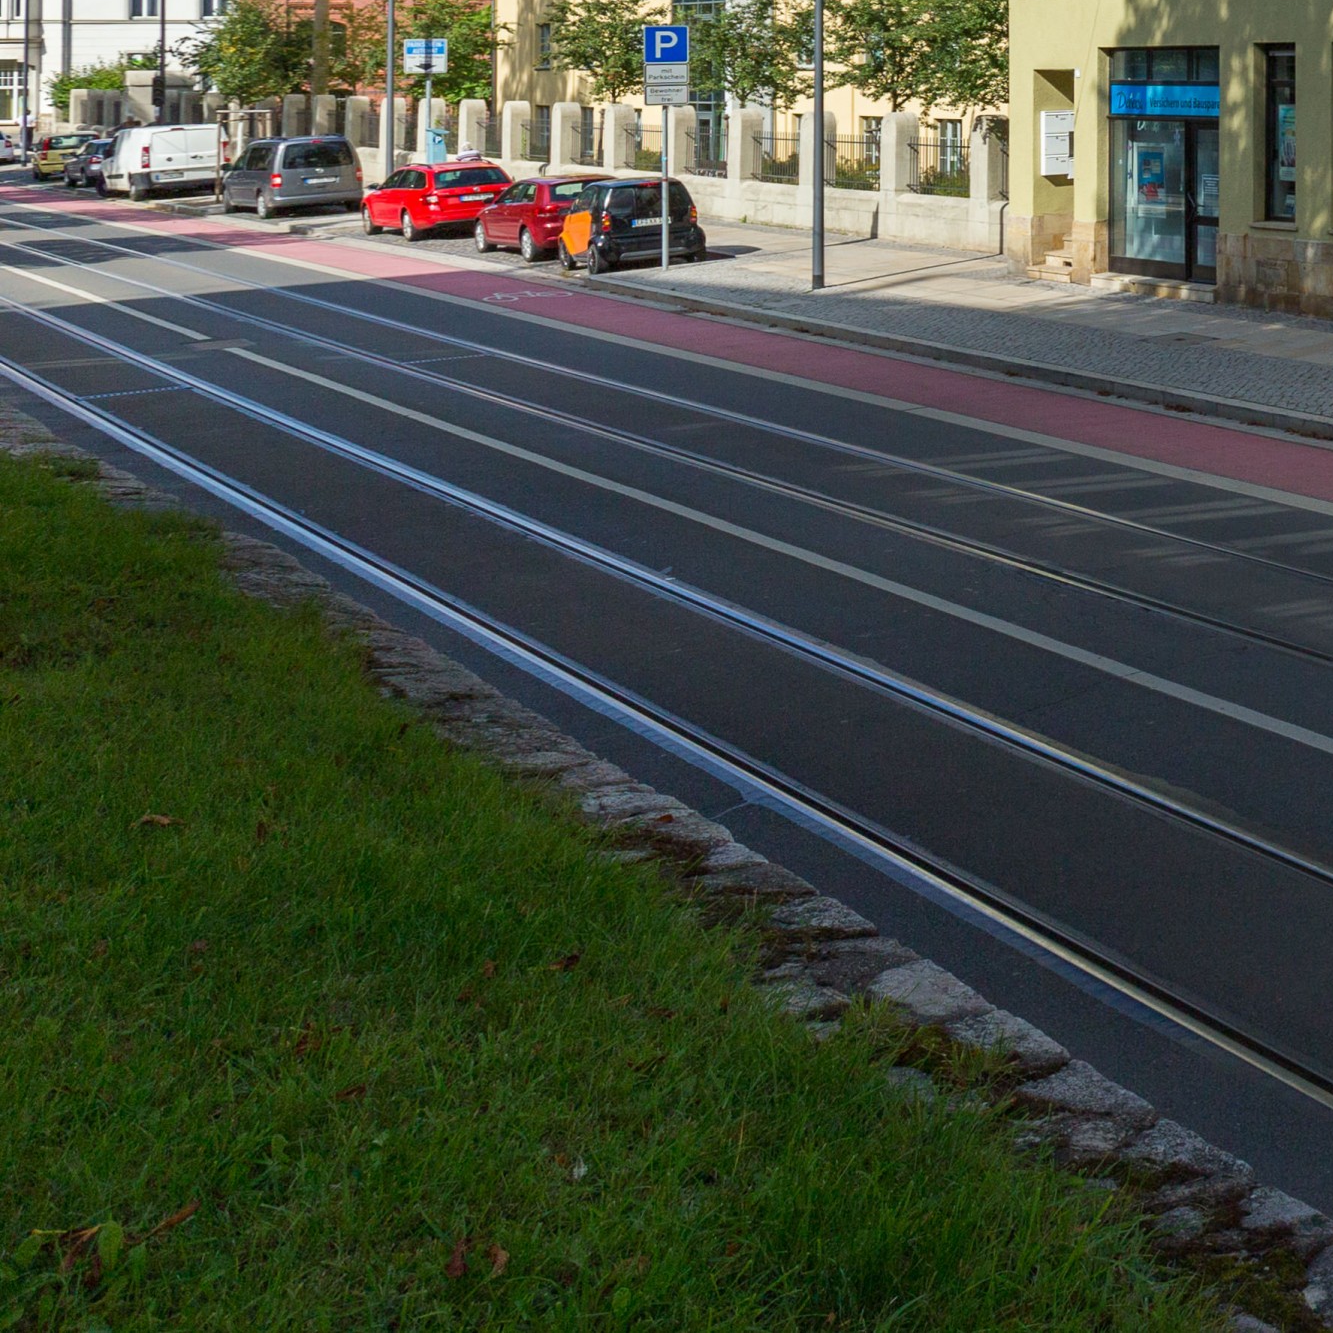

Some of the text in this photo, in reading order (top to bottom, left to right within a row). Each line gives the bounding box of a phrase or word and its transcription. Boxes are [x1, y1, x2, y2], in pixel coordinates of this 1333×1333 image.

[655, 31, 678, 58] P
[1149, 97, 1179, 108] Versichern
[1180, 97, 1192, 108] und
